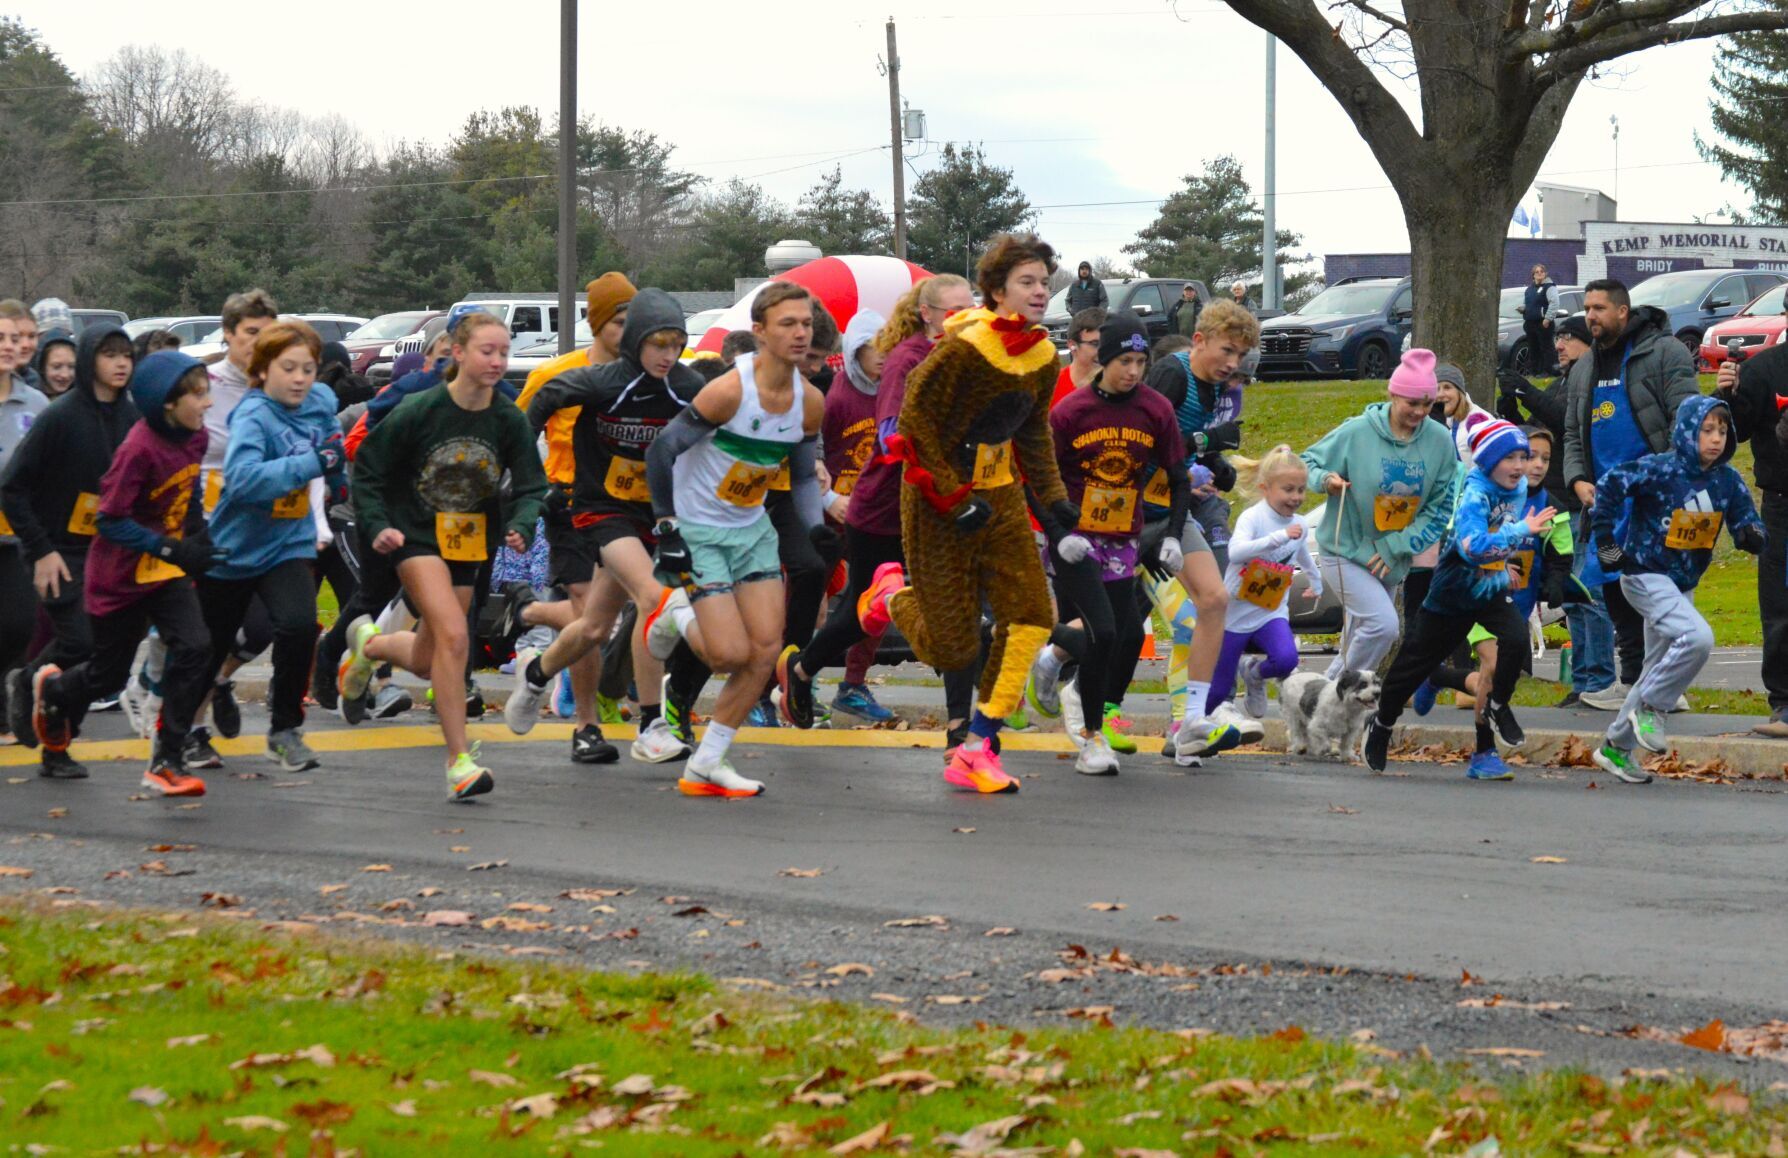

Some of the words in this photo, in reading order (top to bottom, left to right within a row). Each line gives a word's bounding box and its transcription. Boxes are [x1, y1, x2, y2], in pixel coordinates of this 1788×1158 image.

[1602, 236, 1649, 254] KEMP
[1659, 233, 1749, 249] MEMORIAL
[1636, 259, 1673, 272] BRIDY
[1072, 426, 1119, 449] SHAMOKIN
[615, 475, 634, 490] 96
[728, 480, 752, 498] 108
[1091, 507, 1110, 522] 48
[446, 534, 462, 549] 26
[1676, 527, 1697, 541] 115
